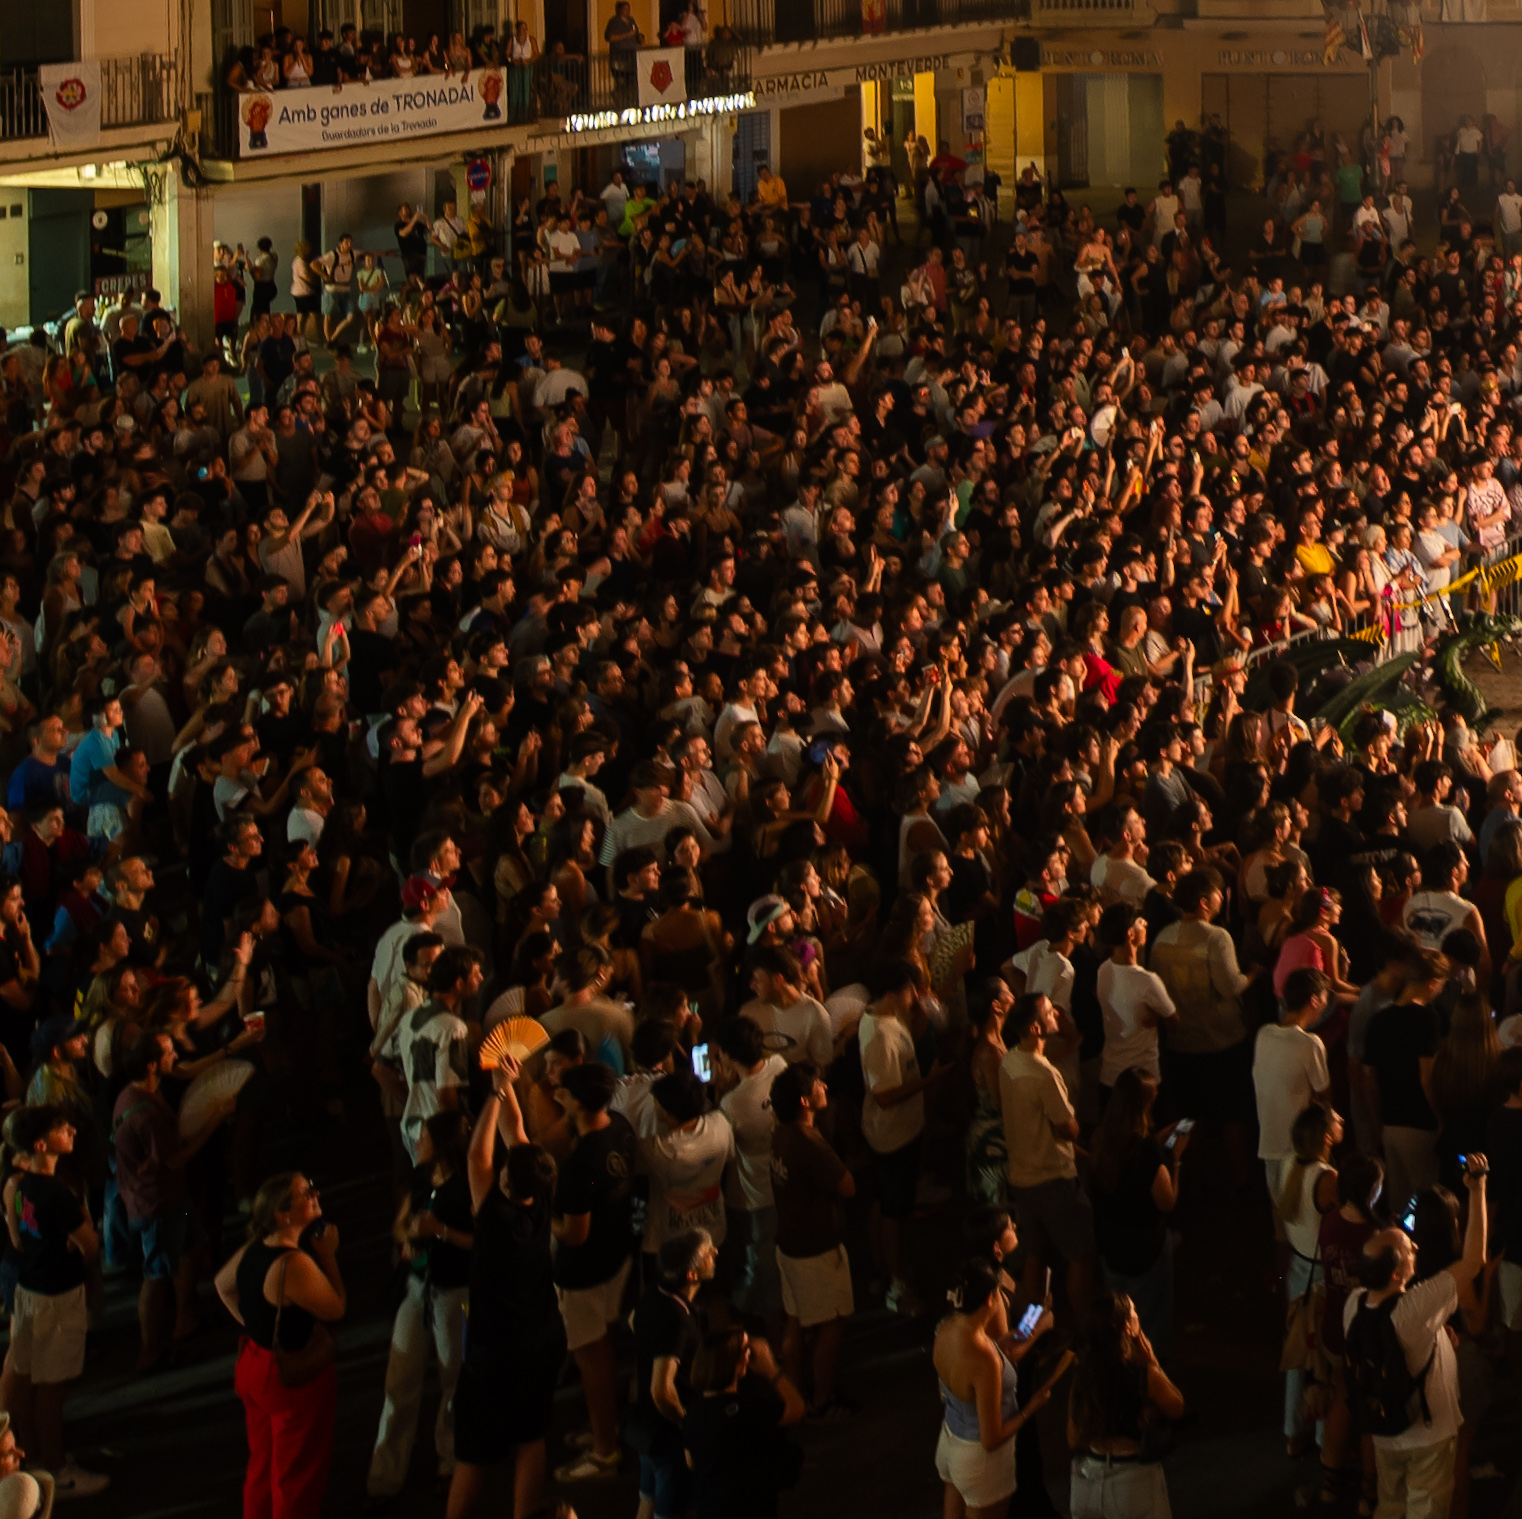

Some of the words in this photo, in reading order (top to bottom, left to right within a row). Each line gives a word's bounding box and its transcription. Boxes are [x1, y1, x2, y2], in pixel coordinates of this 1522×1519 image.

[855, 56, 950, 82] MONTEVERDE
[278, 104, 317, 125] Amb
[320, 101, 367, 127] ganes
[370, 97, 390, 117] de
[321, 127, 376, 143] Guardadors
[377, 122, 390, 136] de
[390, 121, 400, 135] la
